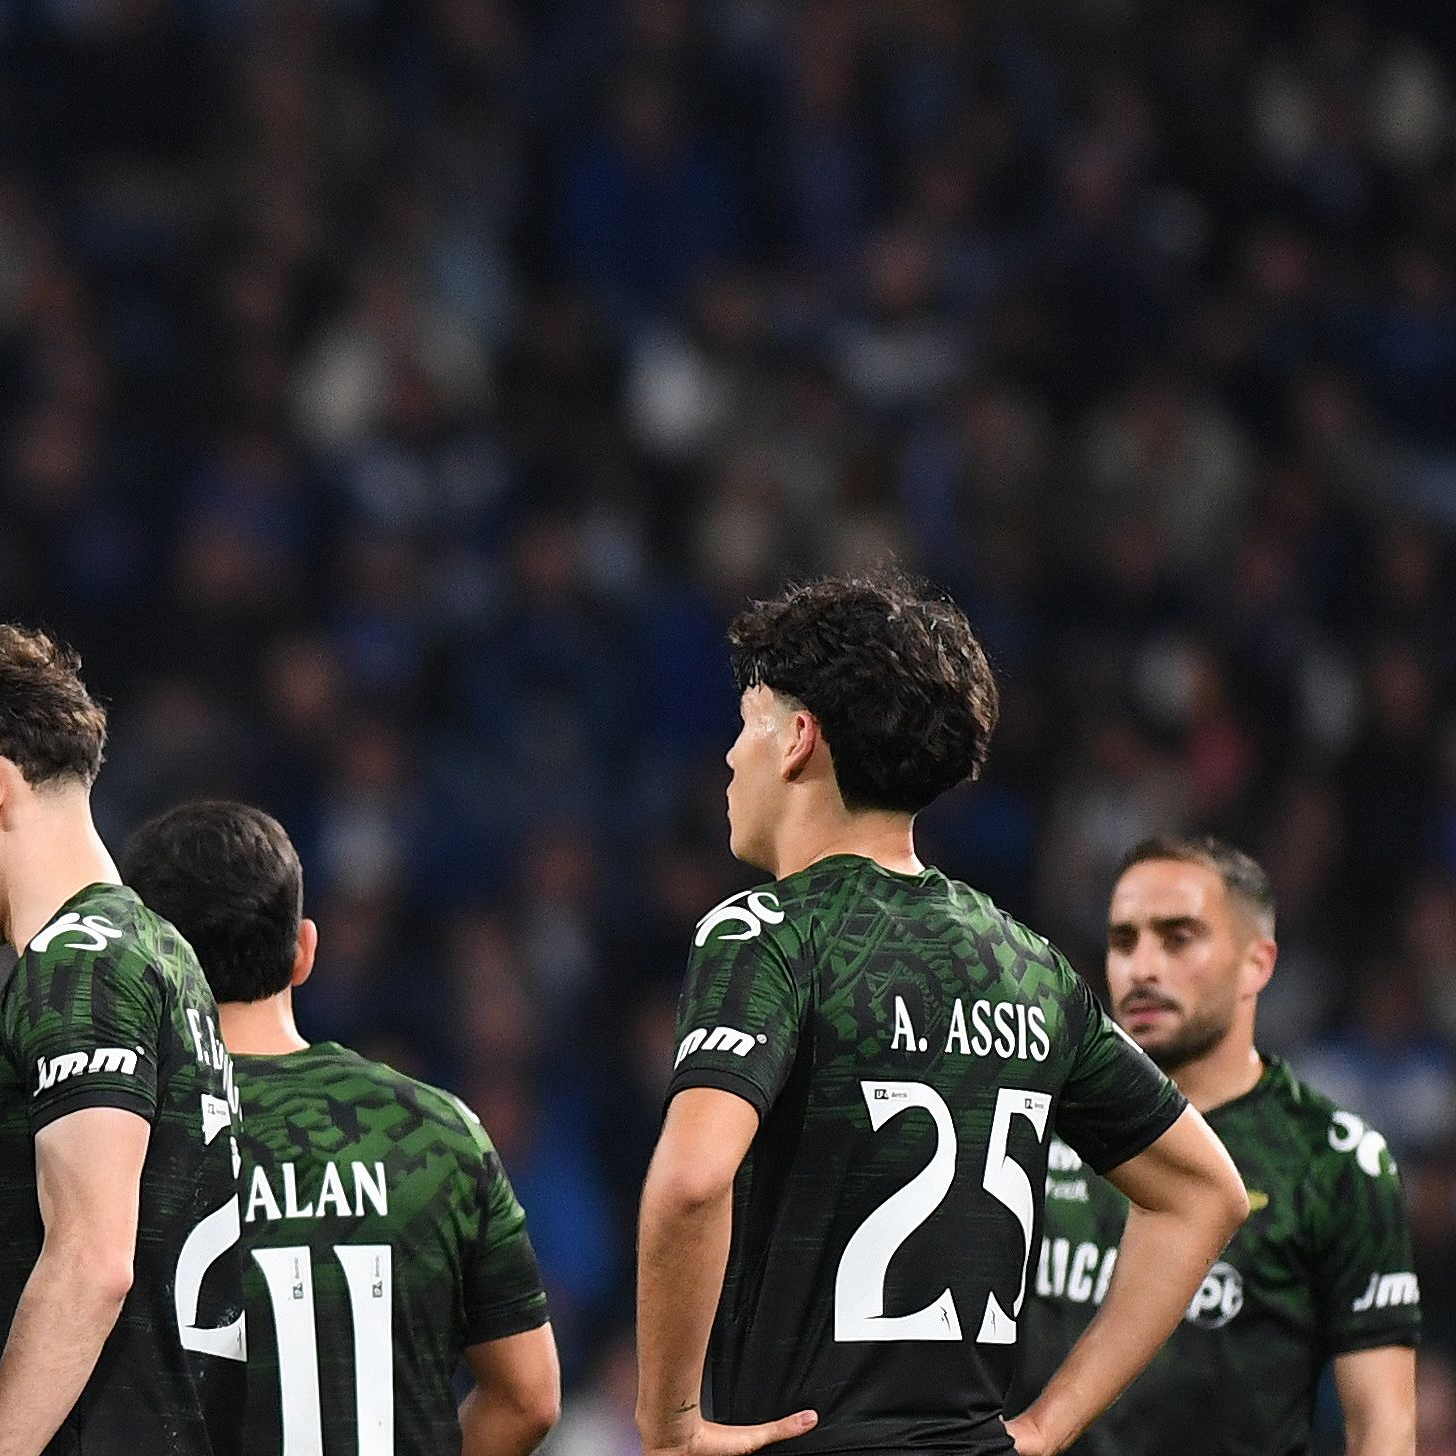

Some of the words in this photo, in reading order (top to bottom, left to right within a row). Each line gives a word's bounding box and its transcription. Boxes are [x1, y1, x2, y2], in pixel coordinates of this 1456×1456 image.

[891, 995, 928, 1052] A.
[944, 997, 1051, 1063] ASSIS
[244, 1161, 388, 1222] ALAN
[833, 1081, 1052, 1345] 25
